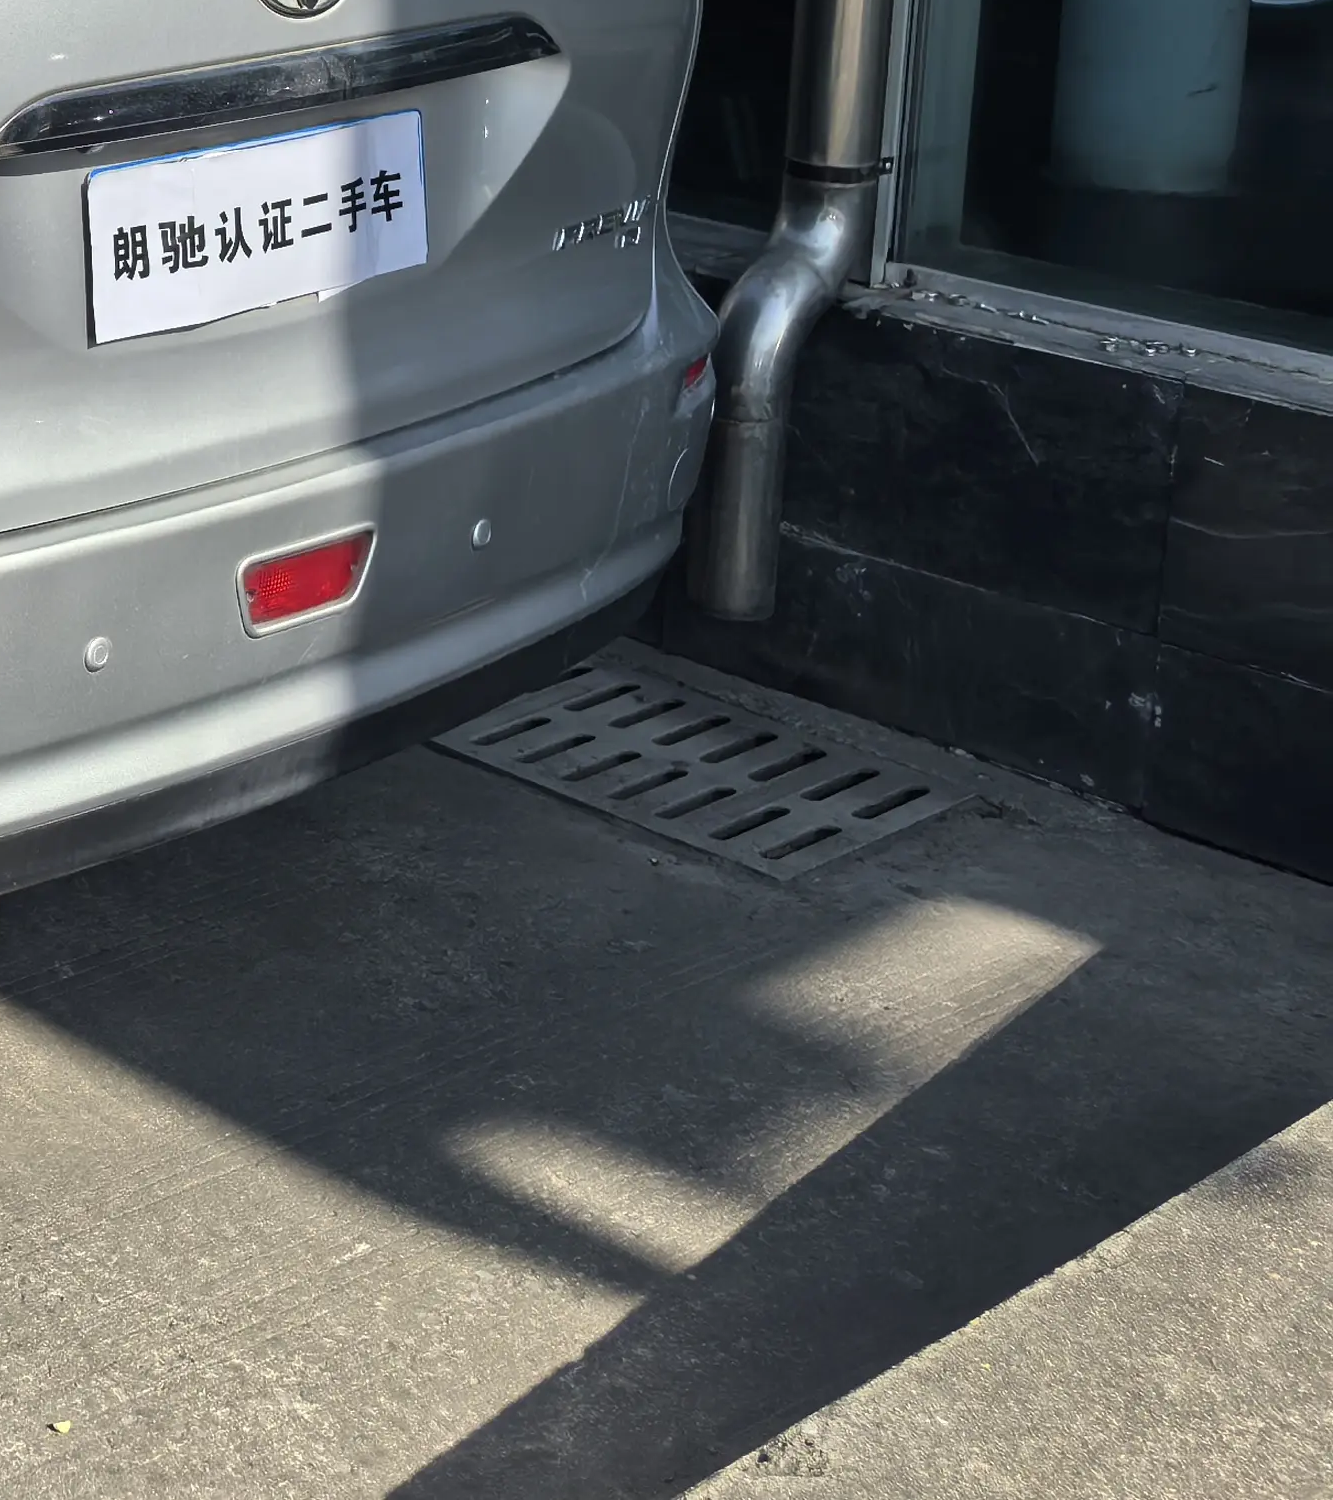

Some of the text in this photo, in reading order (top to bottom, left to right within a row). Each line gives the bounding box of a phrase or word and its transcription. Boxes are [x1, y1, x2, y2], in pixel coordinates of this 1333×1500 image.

[112, 169, 404, 282] 朗驰认证二手车
